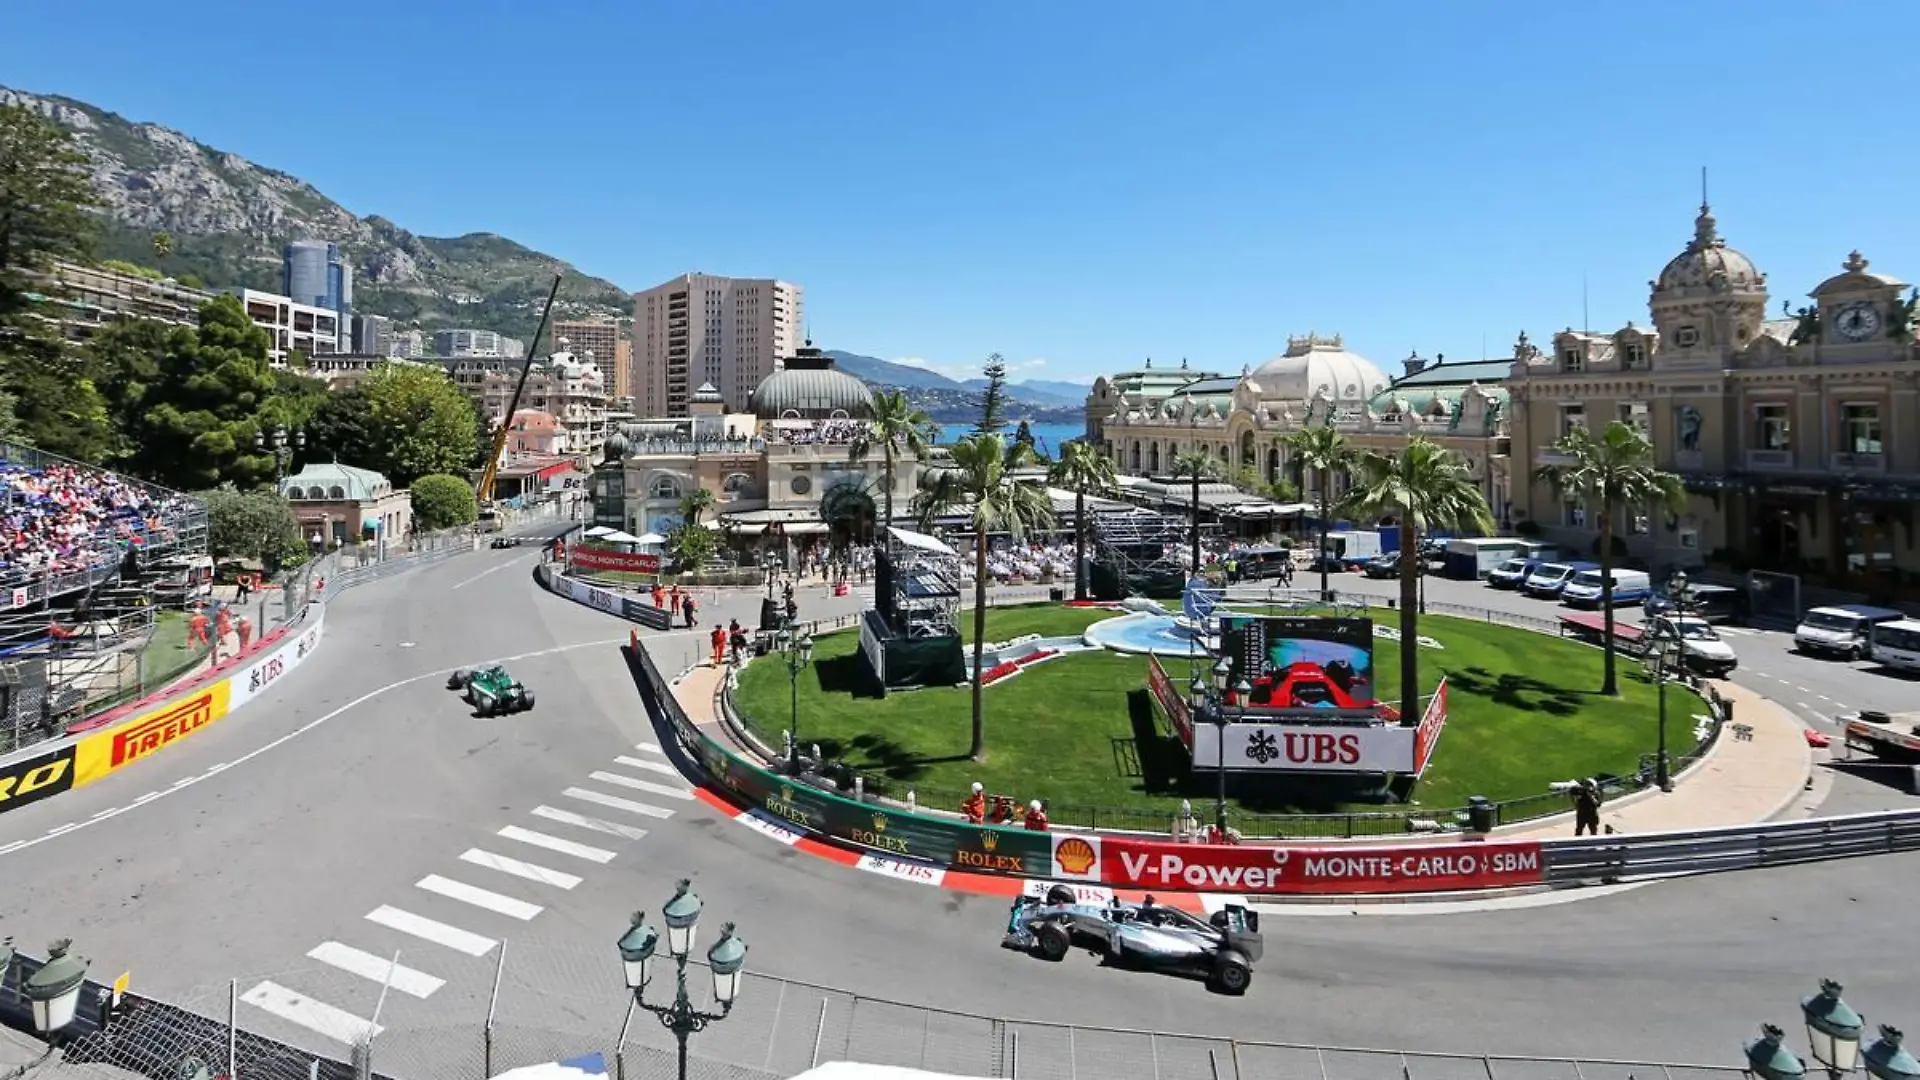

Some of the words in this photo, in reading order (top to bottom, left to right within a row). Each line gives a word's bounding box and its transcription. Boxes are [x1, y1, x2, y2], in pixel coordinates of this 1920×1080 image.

[598, 556, 657, 569] MONTE-CARLO
[110, 693, 213, 769] PIRELLI
[1283, 732, 1360, 764] UBS
[765, 797, 809, 826] ROLEX
[852, 829, 909, 853] ROLEX
[893, 860, 934, 880] UBS
[957, 850, 1024, 871] ROLEX
[1120, 851, 1282, 888] V-Power
[1304, 854, 1476, 878] MONTE-CARLO
[1493, 852, 1537, 872] SBM
[1077, 888, 1105, 902] BS
